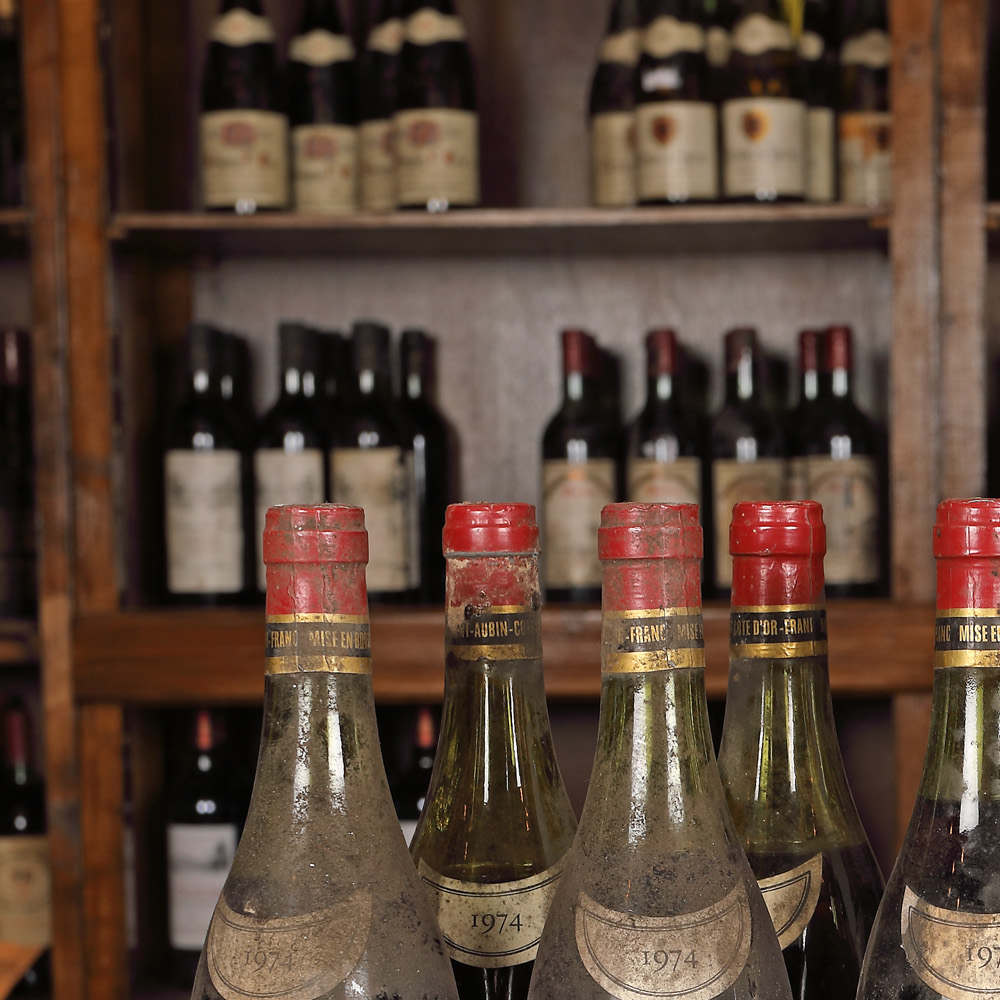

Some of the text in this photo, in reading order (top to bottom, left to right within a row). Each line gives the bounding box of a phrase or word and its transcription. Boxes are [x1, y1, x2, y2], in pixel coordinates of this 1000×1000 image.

[959, 624, 988, 642] MISE
[470, 913, 524, 935] 1974
[243, 950, 294, 973] 1974
[642, 950, 699, 972] 1974
